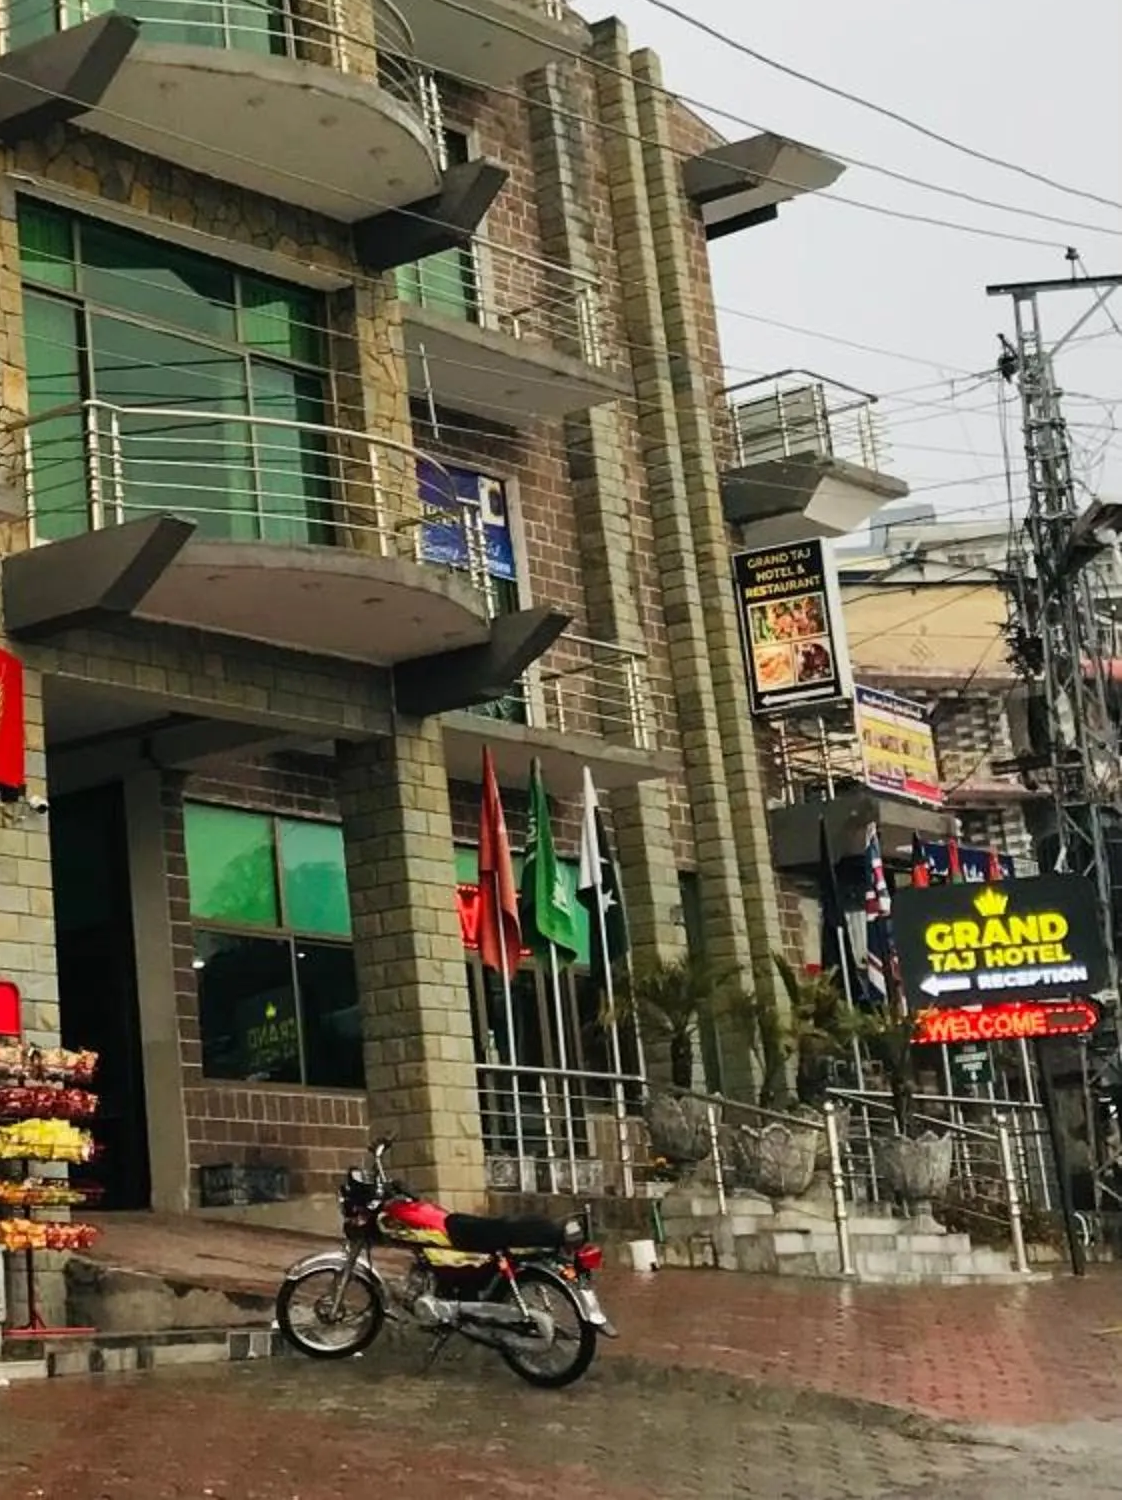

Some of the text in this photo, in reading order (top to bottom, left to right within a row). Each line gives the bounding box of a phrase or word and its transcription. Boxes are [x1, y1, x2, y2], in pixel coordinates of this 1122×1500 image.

[747, 547, 811, 569] GRAND TAJ
[756, 566, 795, 582] HOTEL
[745, 575, 821, 599] RESTAURANT
[925, 913, 1069, 951] GRAND
[928, 943, 1072, 972] TAJ HOTEL
[977, 965, 1088, 990] RECEPTION
[928, 1011, 1046, 1040] WELCOME
